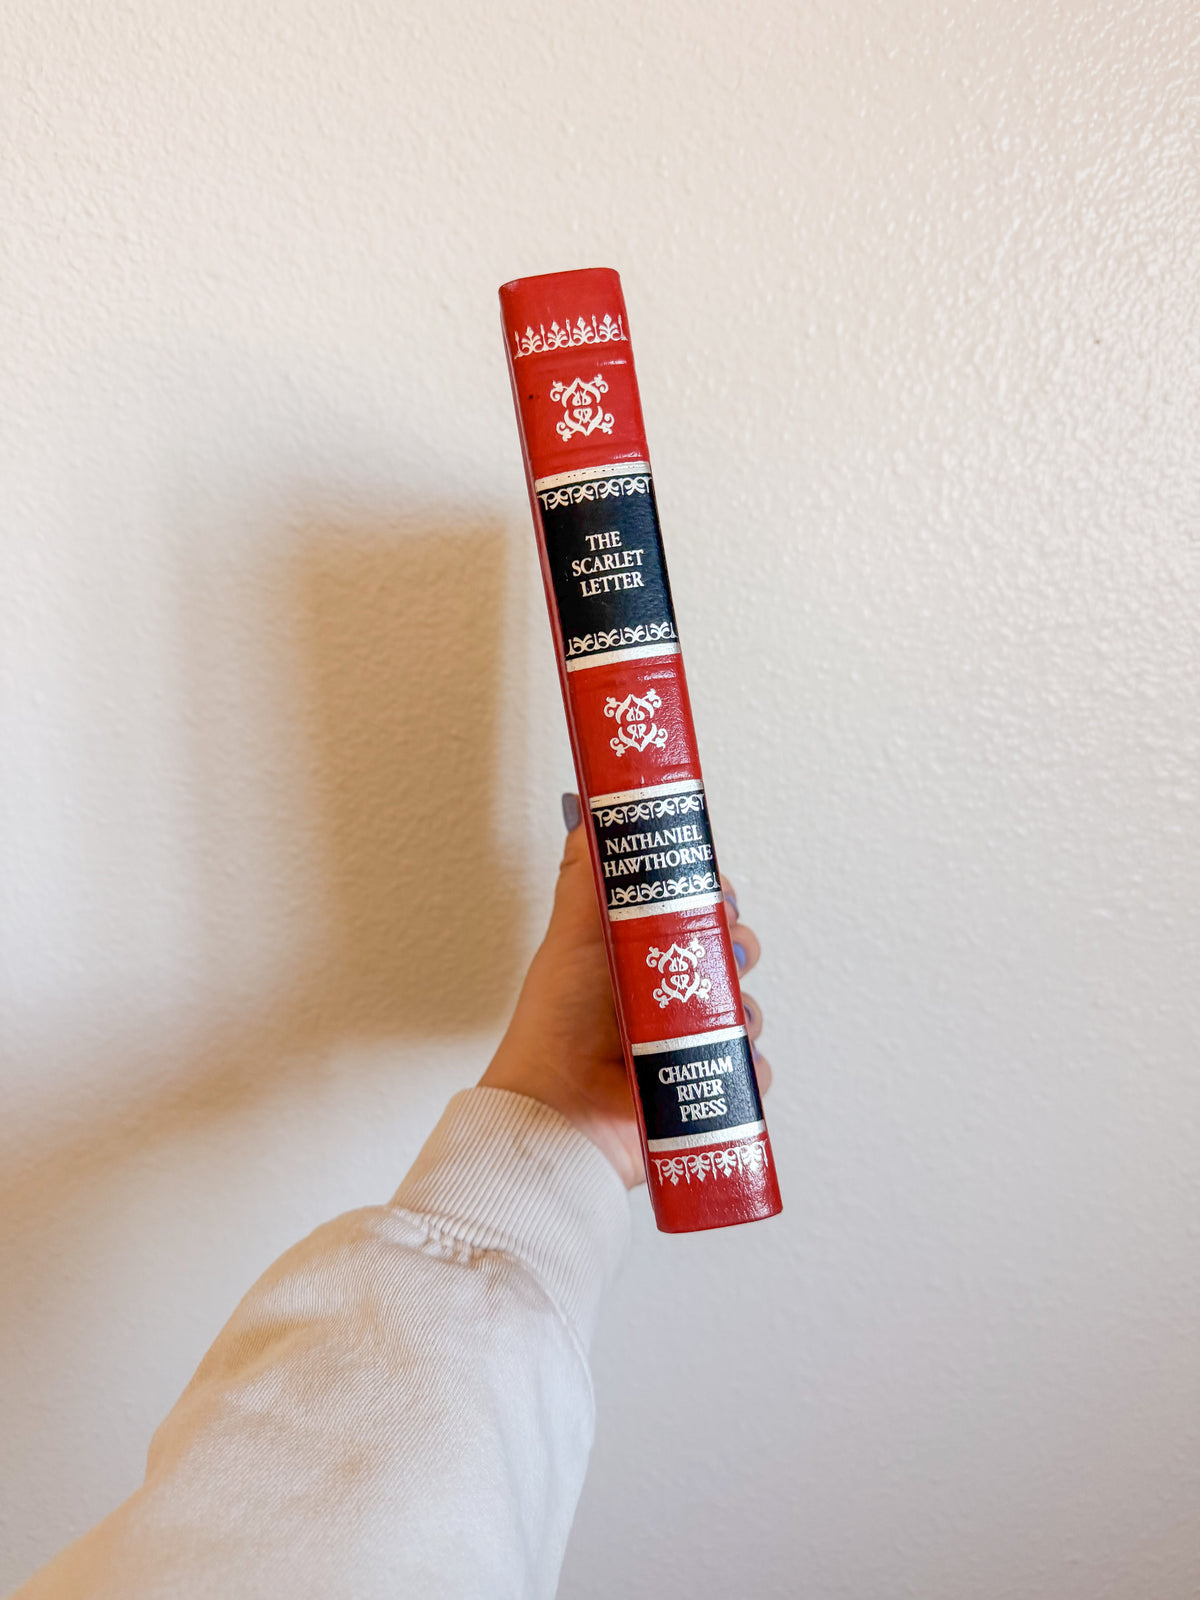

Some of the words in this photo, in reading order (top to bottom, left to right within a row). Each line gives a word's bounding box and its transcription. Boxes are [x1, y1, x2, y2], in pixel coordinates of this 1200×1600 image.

[585, 531, 622, 551] THE
[571, 549, 644, 577] SCARLET
[580, 571, 645, 597] LETTER
[605, 825, 702, 855] NATHANIEL
[603, 844, 713, 877] HAWTHORNE
[658, 1055, 733, 1084] CHATHAM
[676, 1079, 724, 1102] RIVER
[679, 1098, 727, 1123] PRESS
